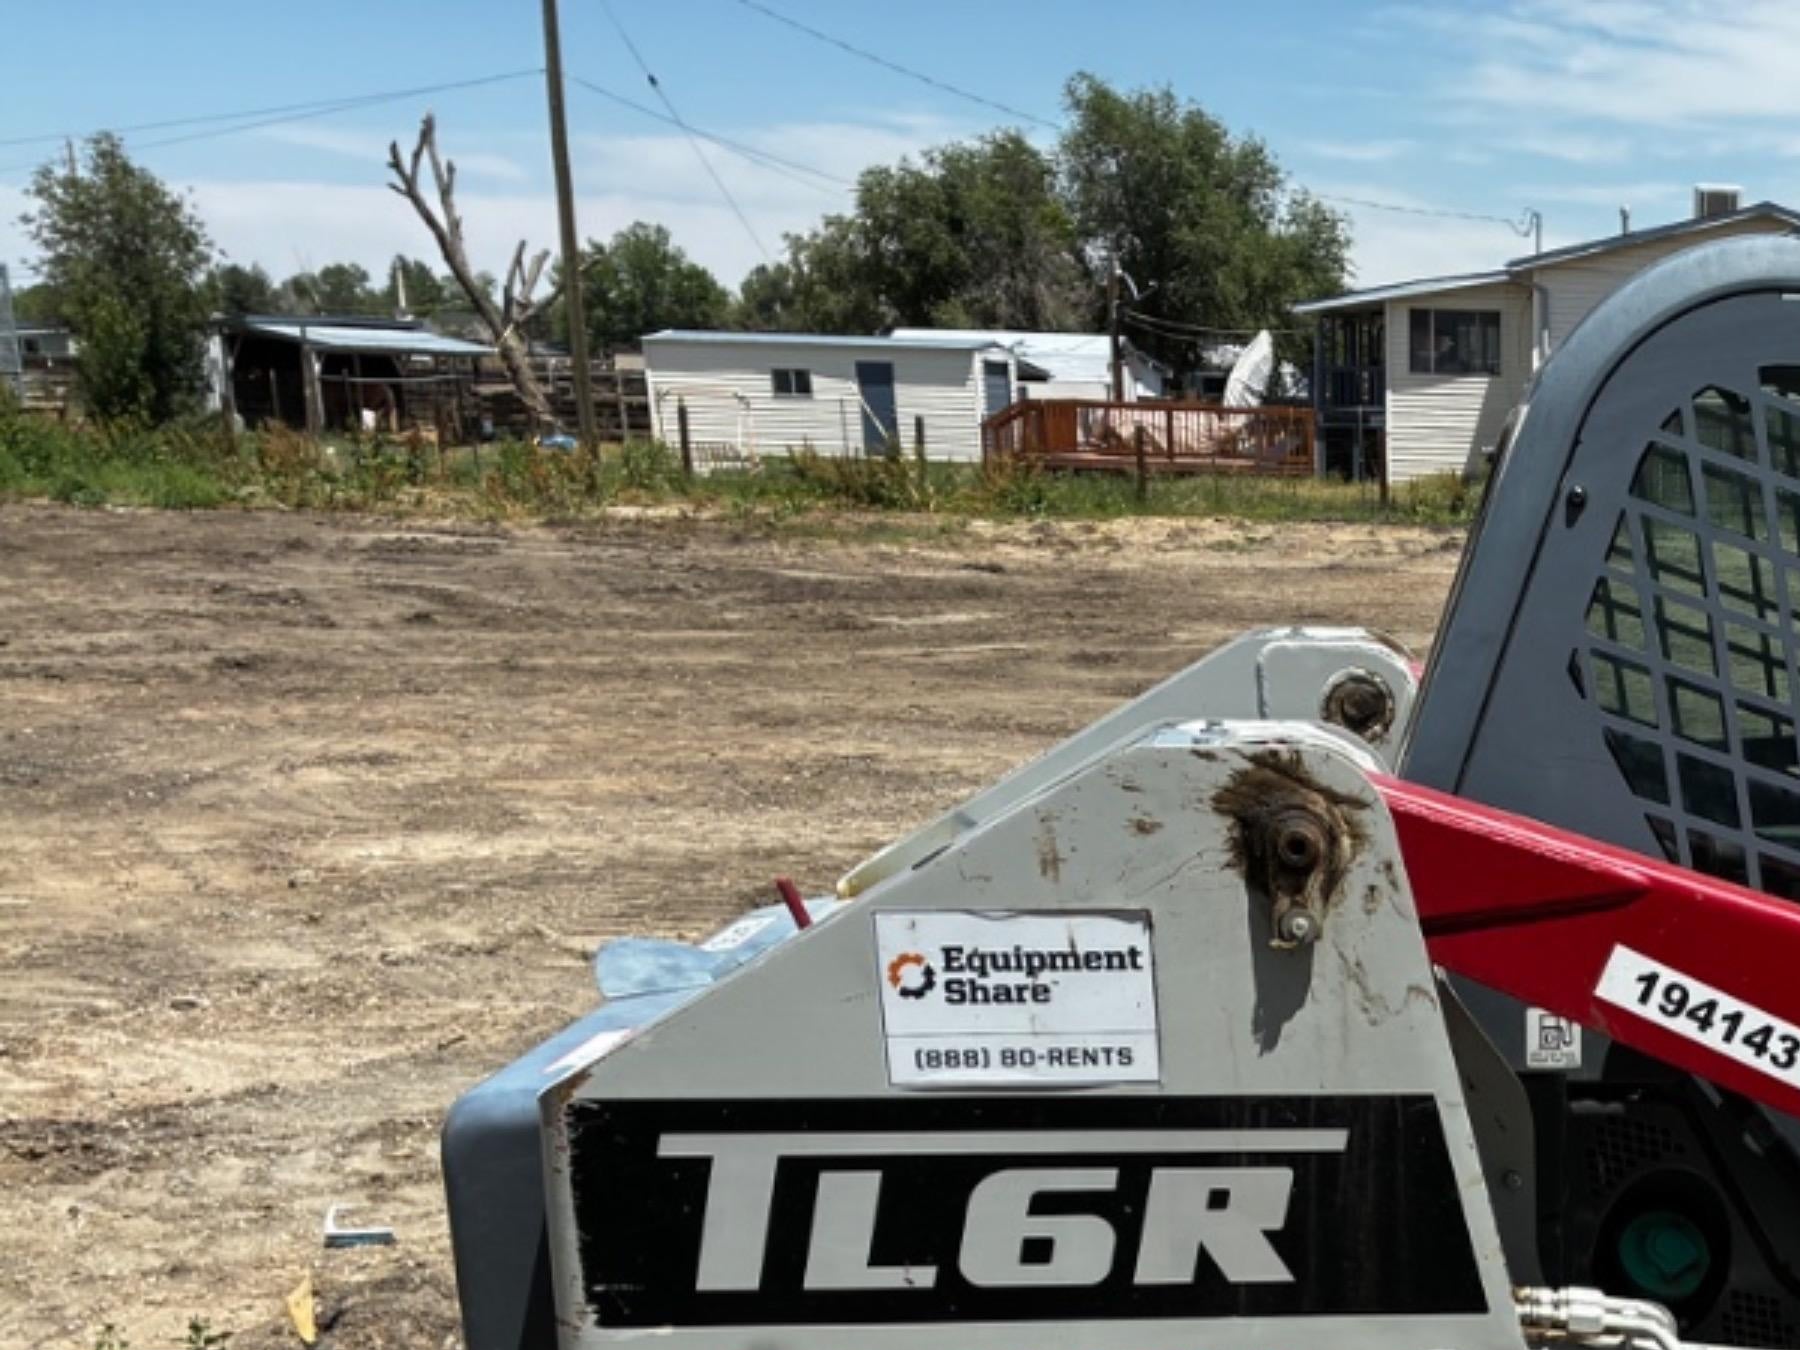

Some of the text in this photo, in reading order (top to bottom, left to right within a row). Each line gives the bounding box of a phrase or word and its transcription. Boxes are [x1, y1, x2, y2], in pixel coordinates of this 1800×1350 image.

[940, 944, 1143, 979] Equipment
[914, 1047, 990, 1070] (888)
[656, 1128, 1349, 1291] TL6R
